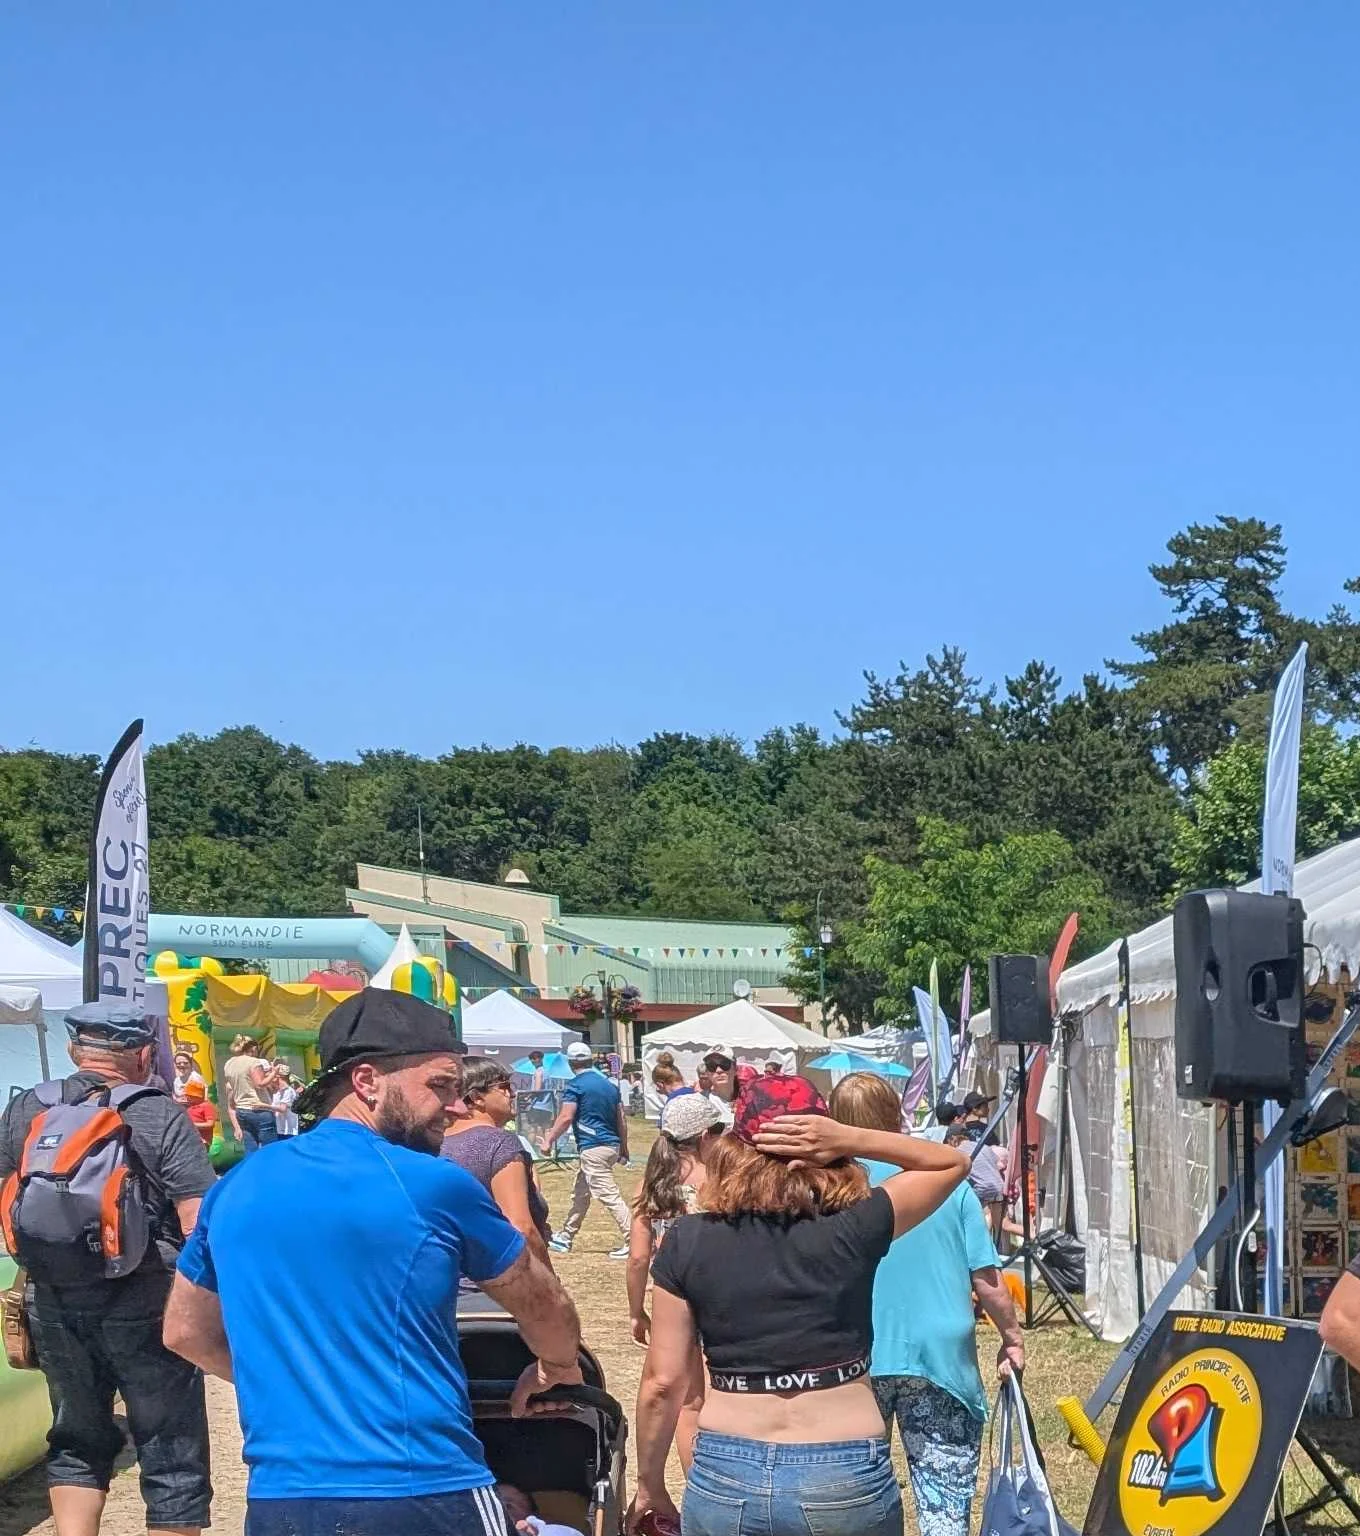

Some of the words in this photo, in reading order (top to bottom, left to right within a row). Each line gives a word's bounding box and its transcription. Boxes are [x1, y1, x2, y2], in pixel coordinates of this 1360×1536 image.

[179, 924, 304, 939] NORMANDIE
[212, 940, 236, 948] SUD
[241, 941, 273, 950] EURE
[1174, 1316, 1200, 1332] VOTRE
[1200, 1318, 1225, 1334] RADIO
[1226, 1321, 1286, 1341] ASSOCIATIVE
[714, 1374, 749, 1391] OVE
[765, 1373, 820, 1391] LOVE
[837, 1357, 873, 1382] LOV
[1161, 1367, 1189, 1397] RADIO
[1193, 1359, 1232, 1376] PRINCIPE
[1231, 1373, 1251, 1406] ACTIF
